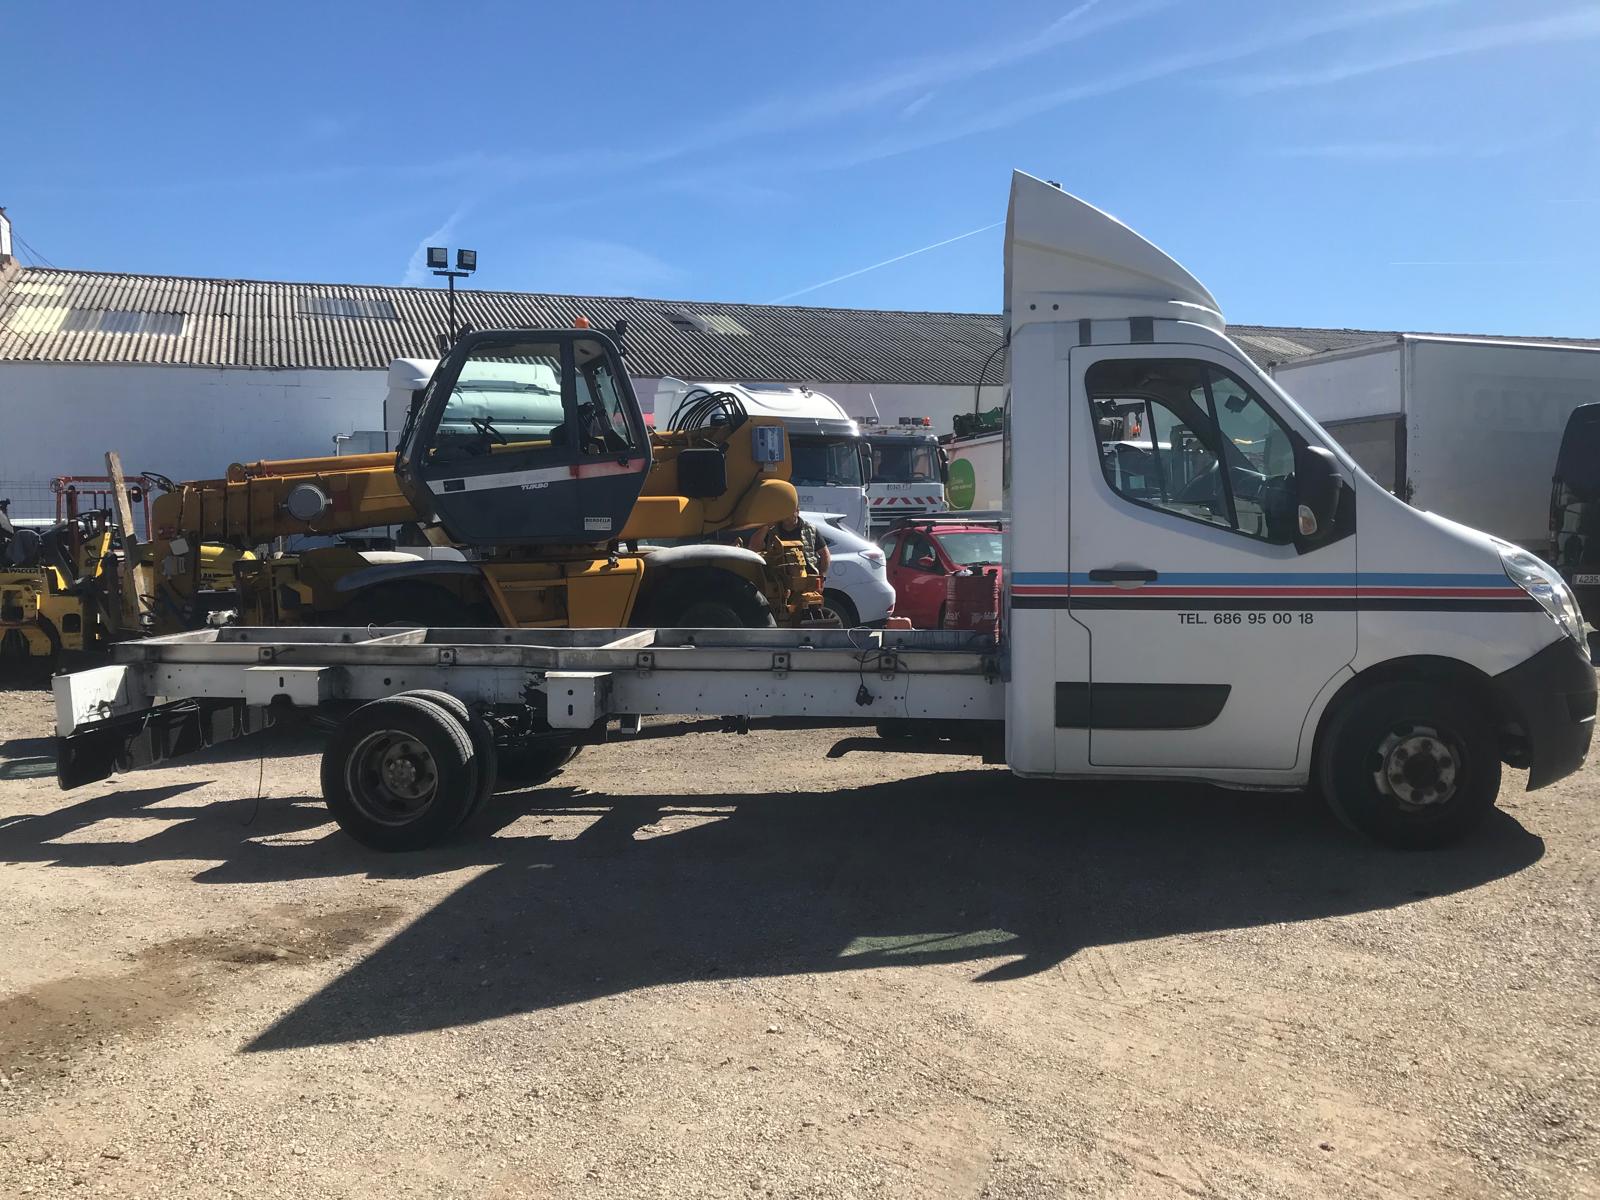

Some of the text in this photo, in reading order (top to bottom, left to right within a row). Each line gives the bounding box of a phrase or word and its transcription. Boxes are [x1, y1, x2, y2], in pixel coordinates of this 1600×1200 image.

[1177, 612, 1314, 625] TEL. 686 95 00 18
